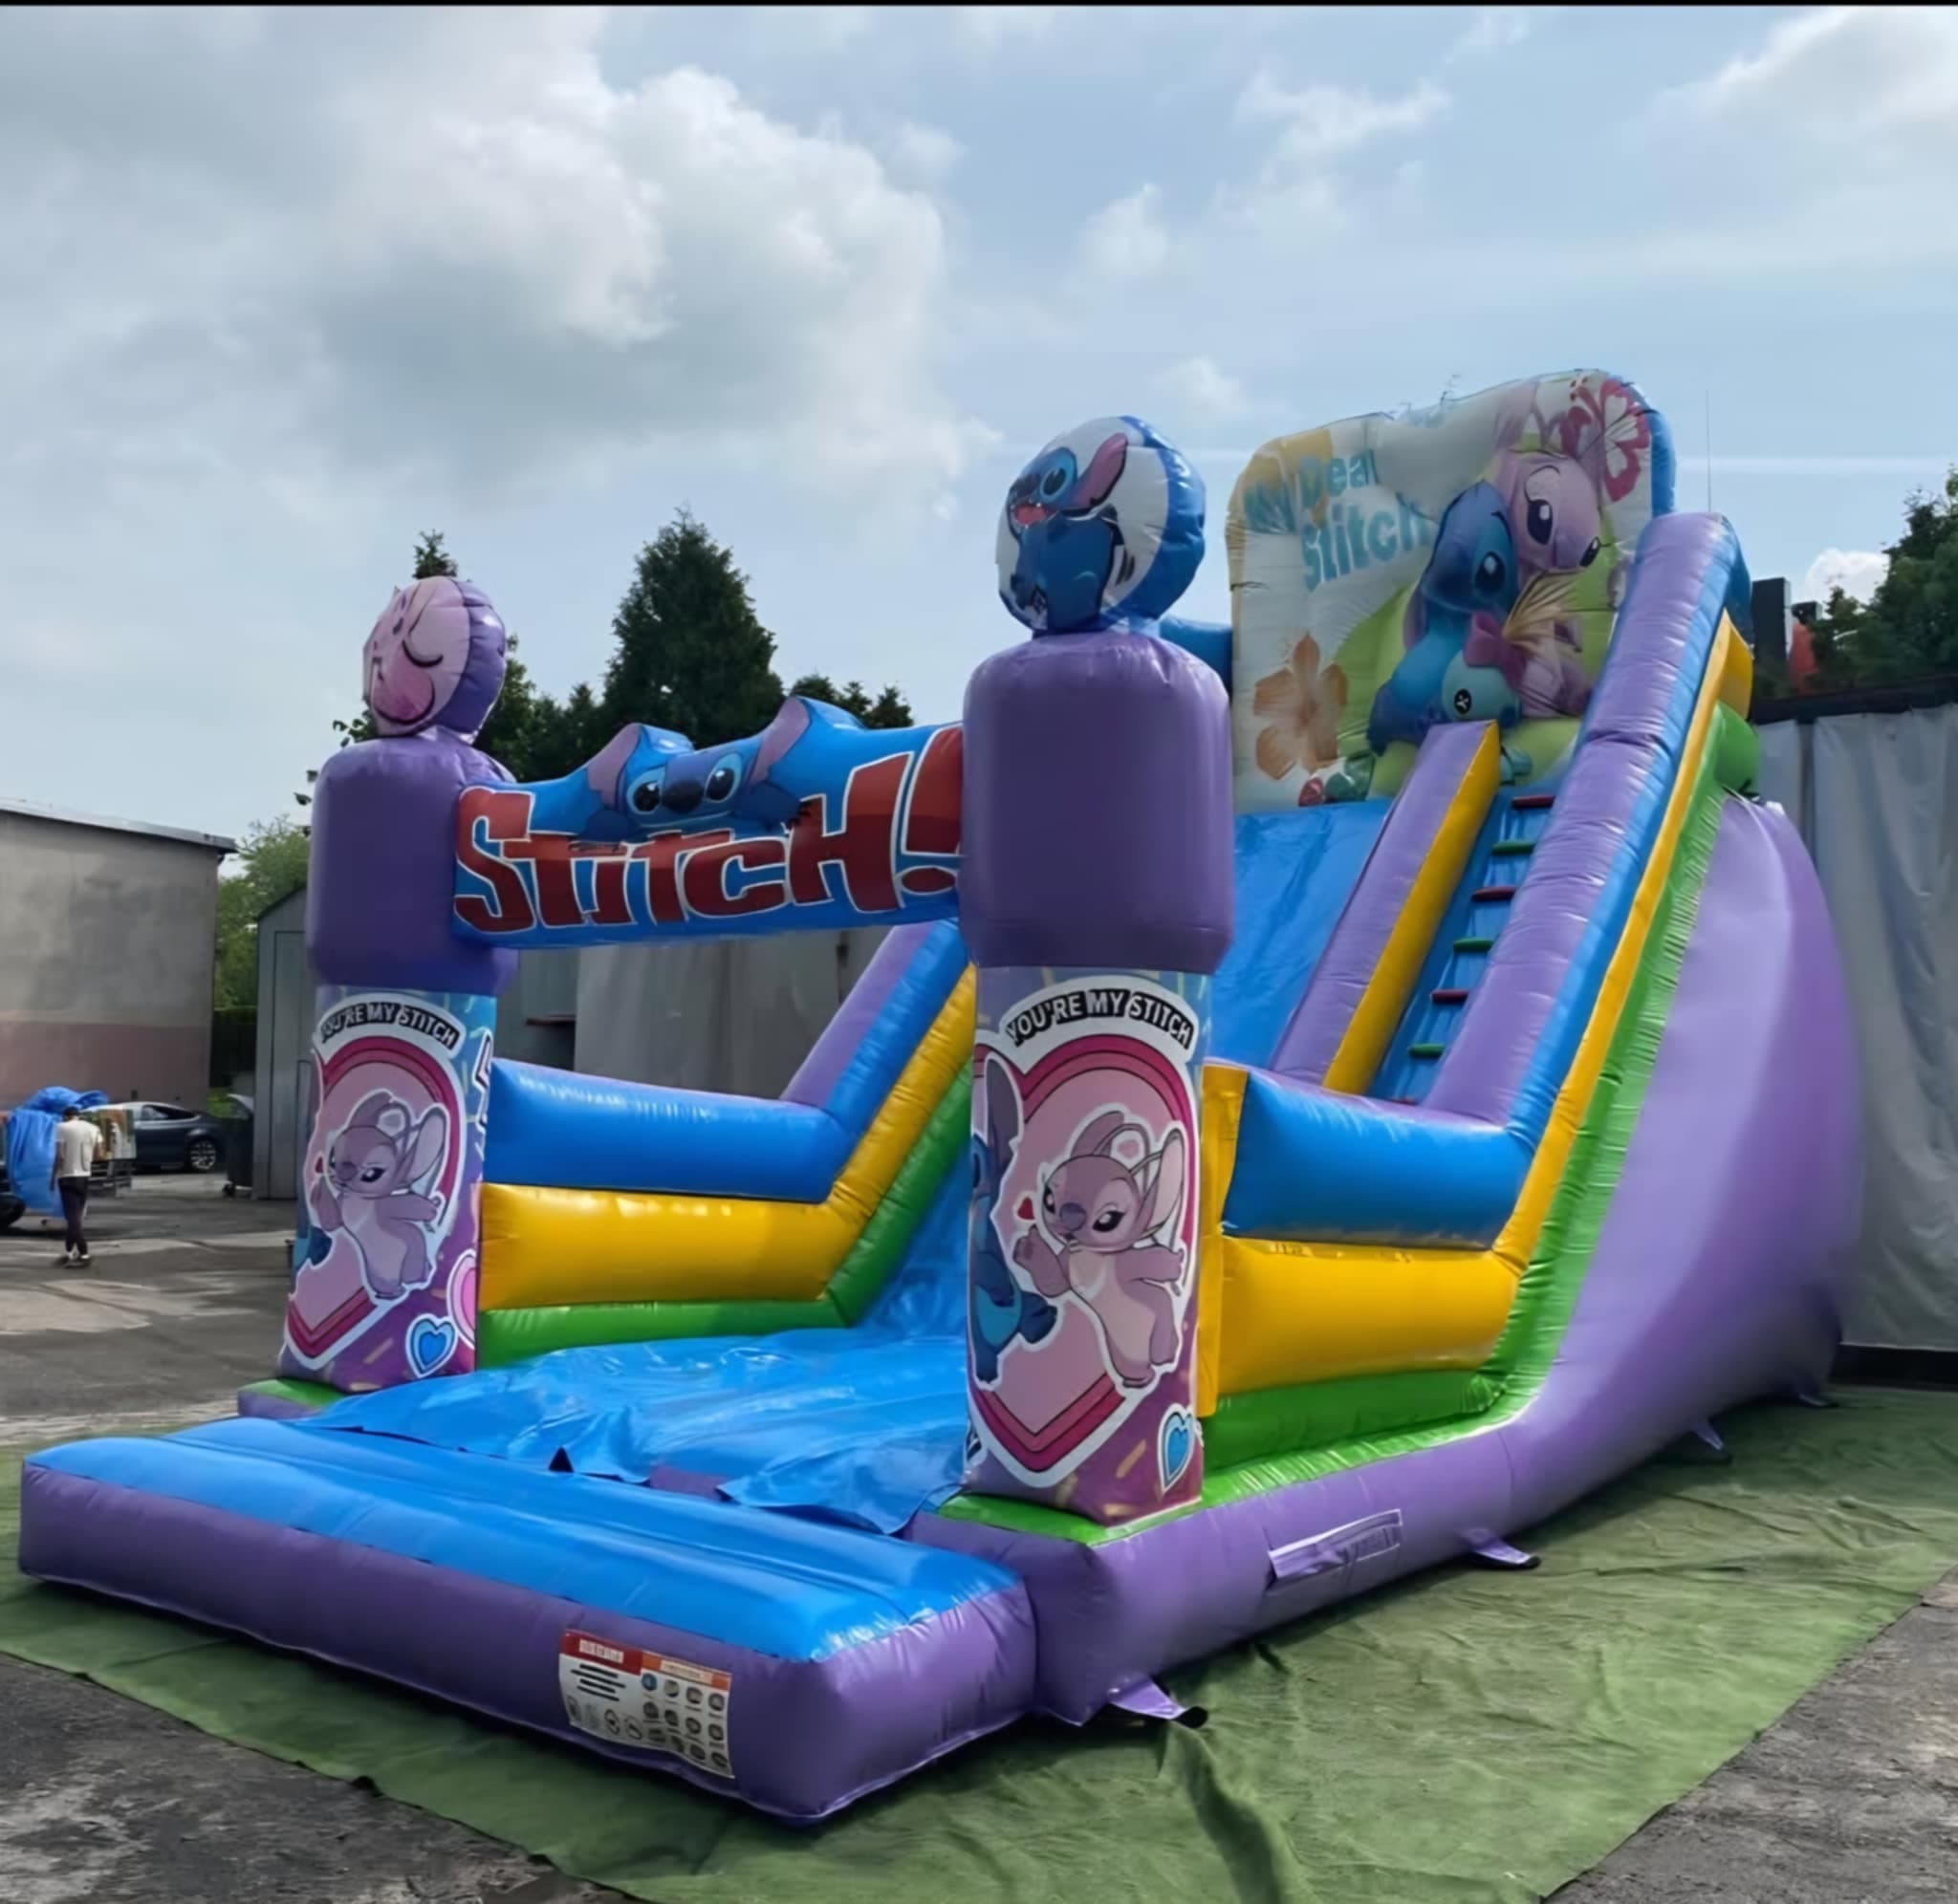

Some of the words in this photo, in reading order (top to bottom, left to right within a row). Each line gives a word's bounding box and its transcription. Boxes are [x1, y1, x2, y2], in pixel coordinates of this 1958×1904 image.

[367, 1002, 398, 1025] MY
[397, 1005, 461, 1050] STITCH
[1006, 990, 1088, 1047] YOU'RE
[1086, 988, 1130, 1018] MY
[1127, 991, 1195, 1049] STITCH
